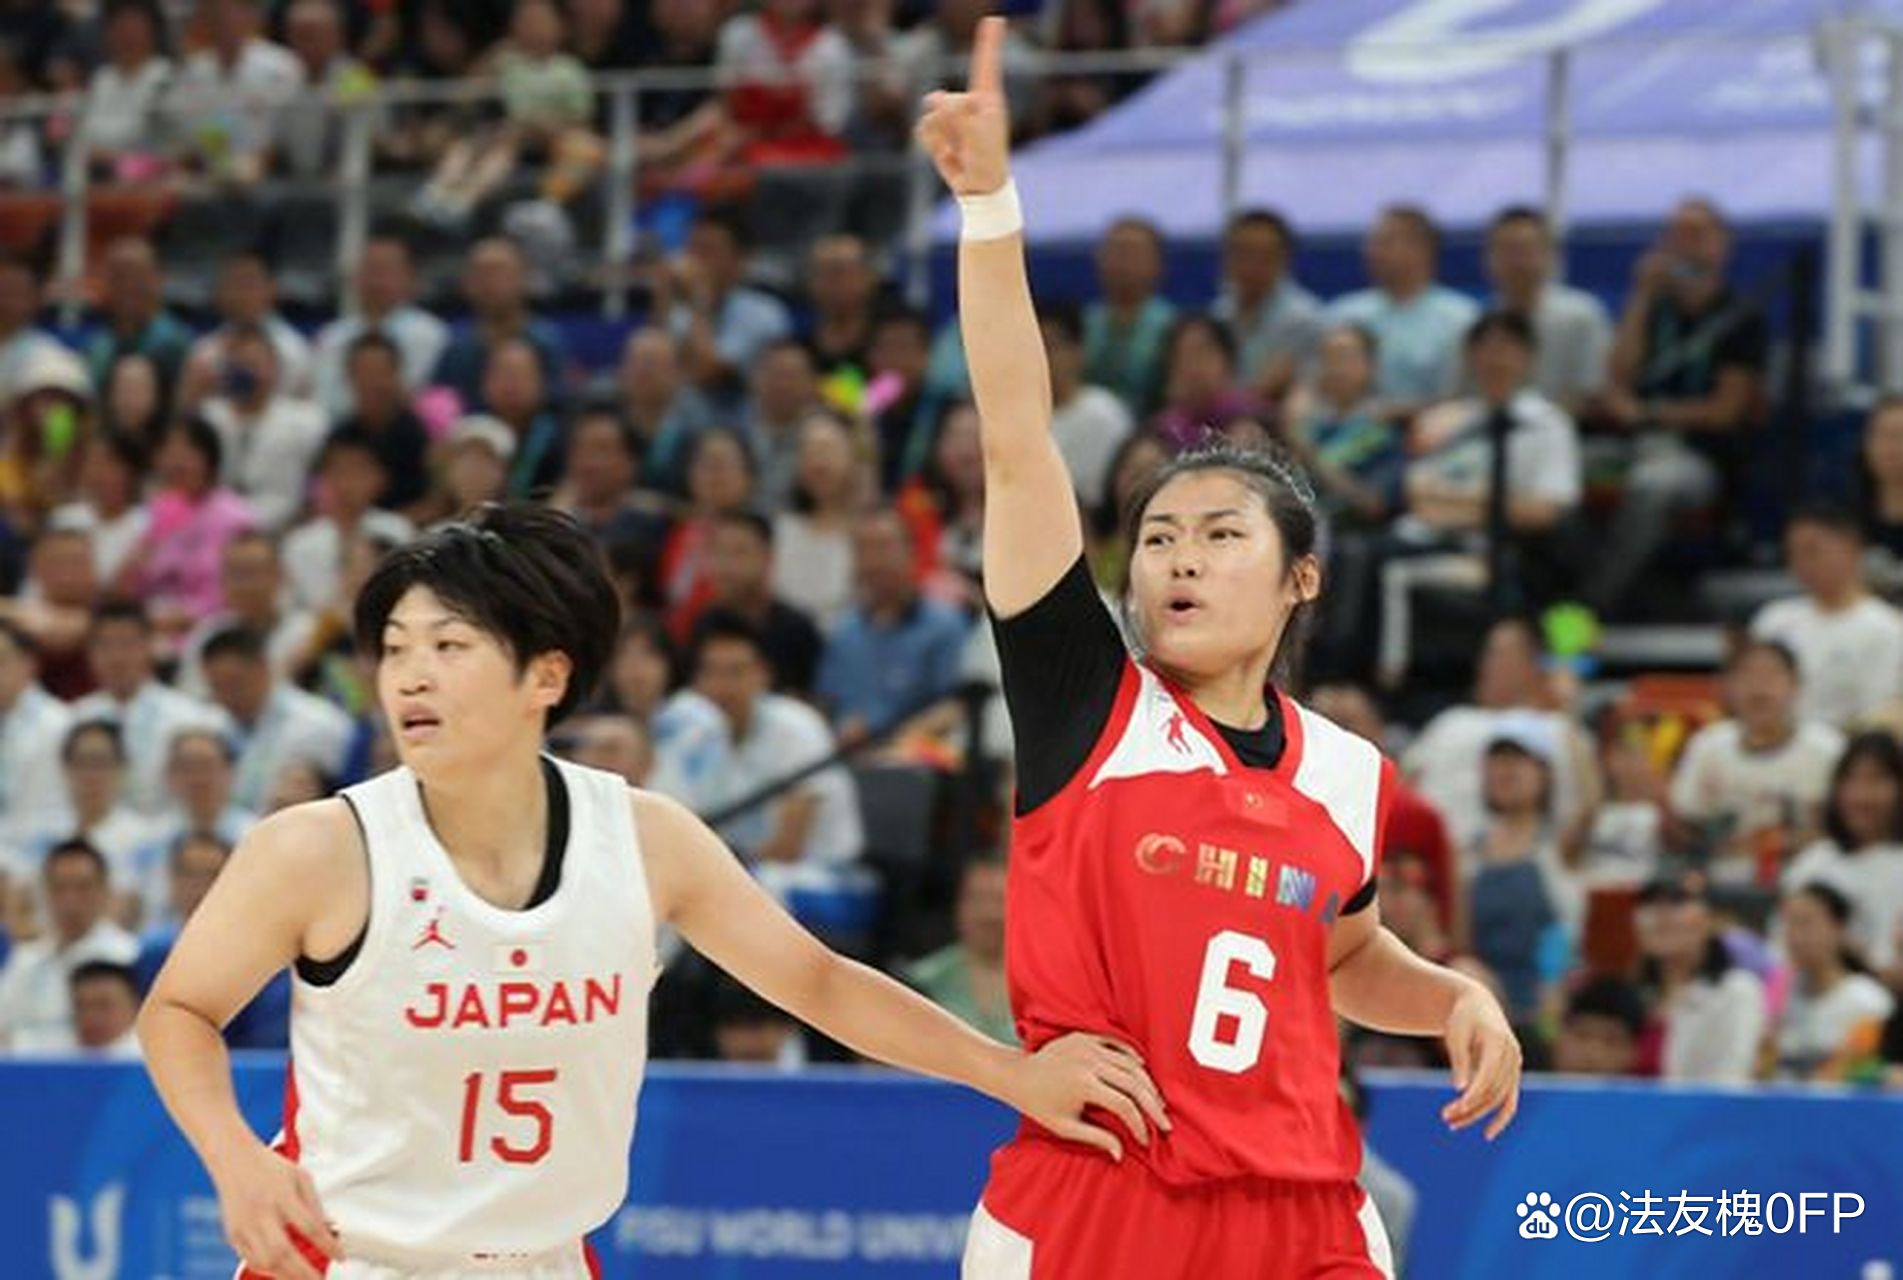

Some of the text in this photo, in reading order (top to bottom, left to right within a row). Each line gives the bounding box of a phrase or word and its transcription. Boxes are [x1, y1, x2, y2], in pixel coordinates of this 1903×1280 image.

[1135, 832, 1340, 923] CHINA
[405, 973, 622, 1028] JAPAN
[1188, 929, 1277, 1074] 6
[460, 1069, 557, 1164] 15
[708, 1209, 851, 1260] WORLD
